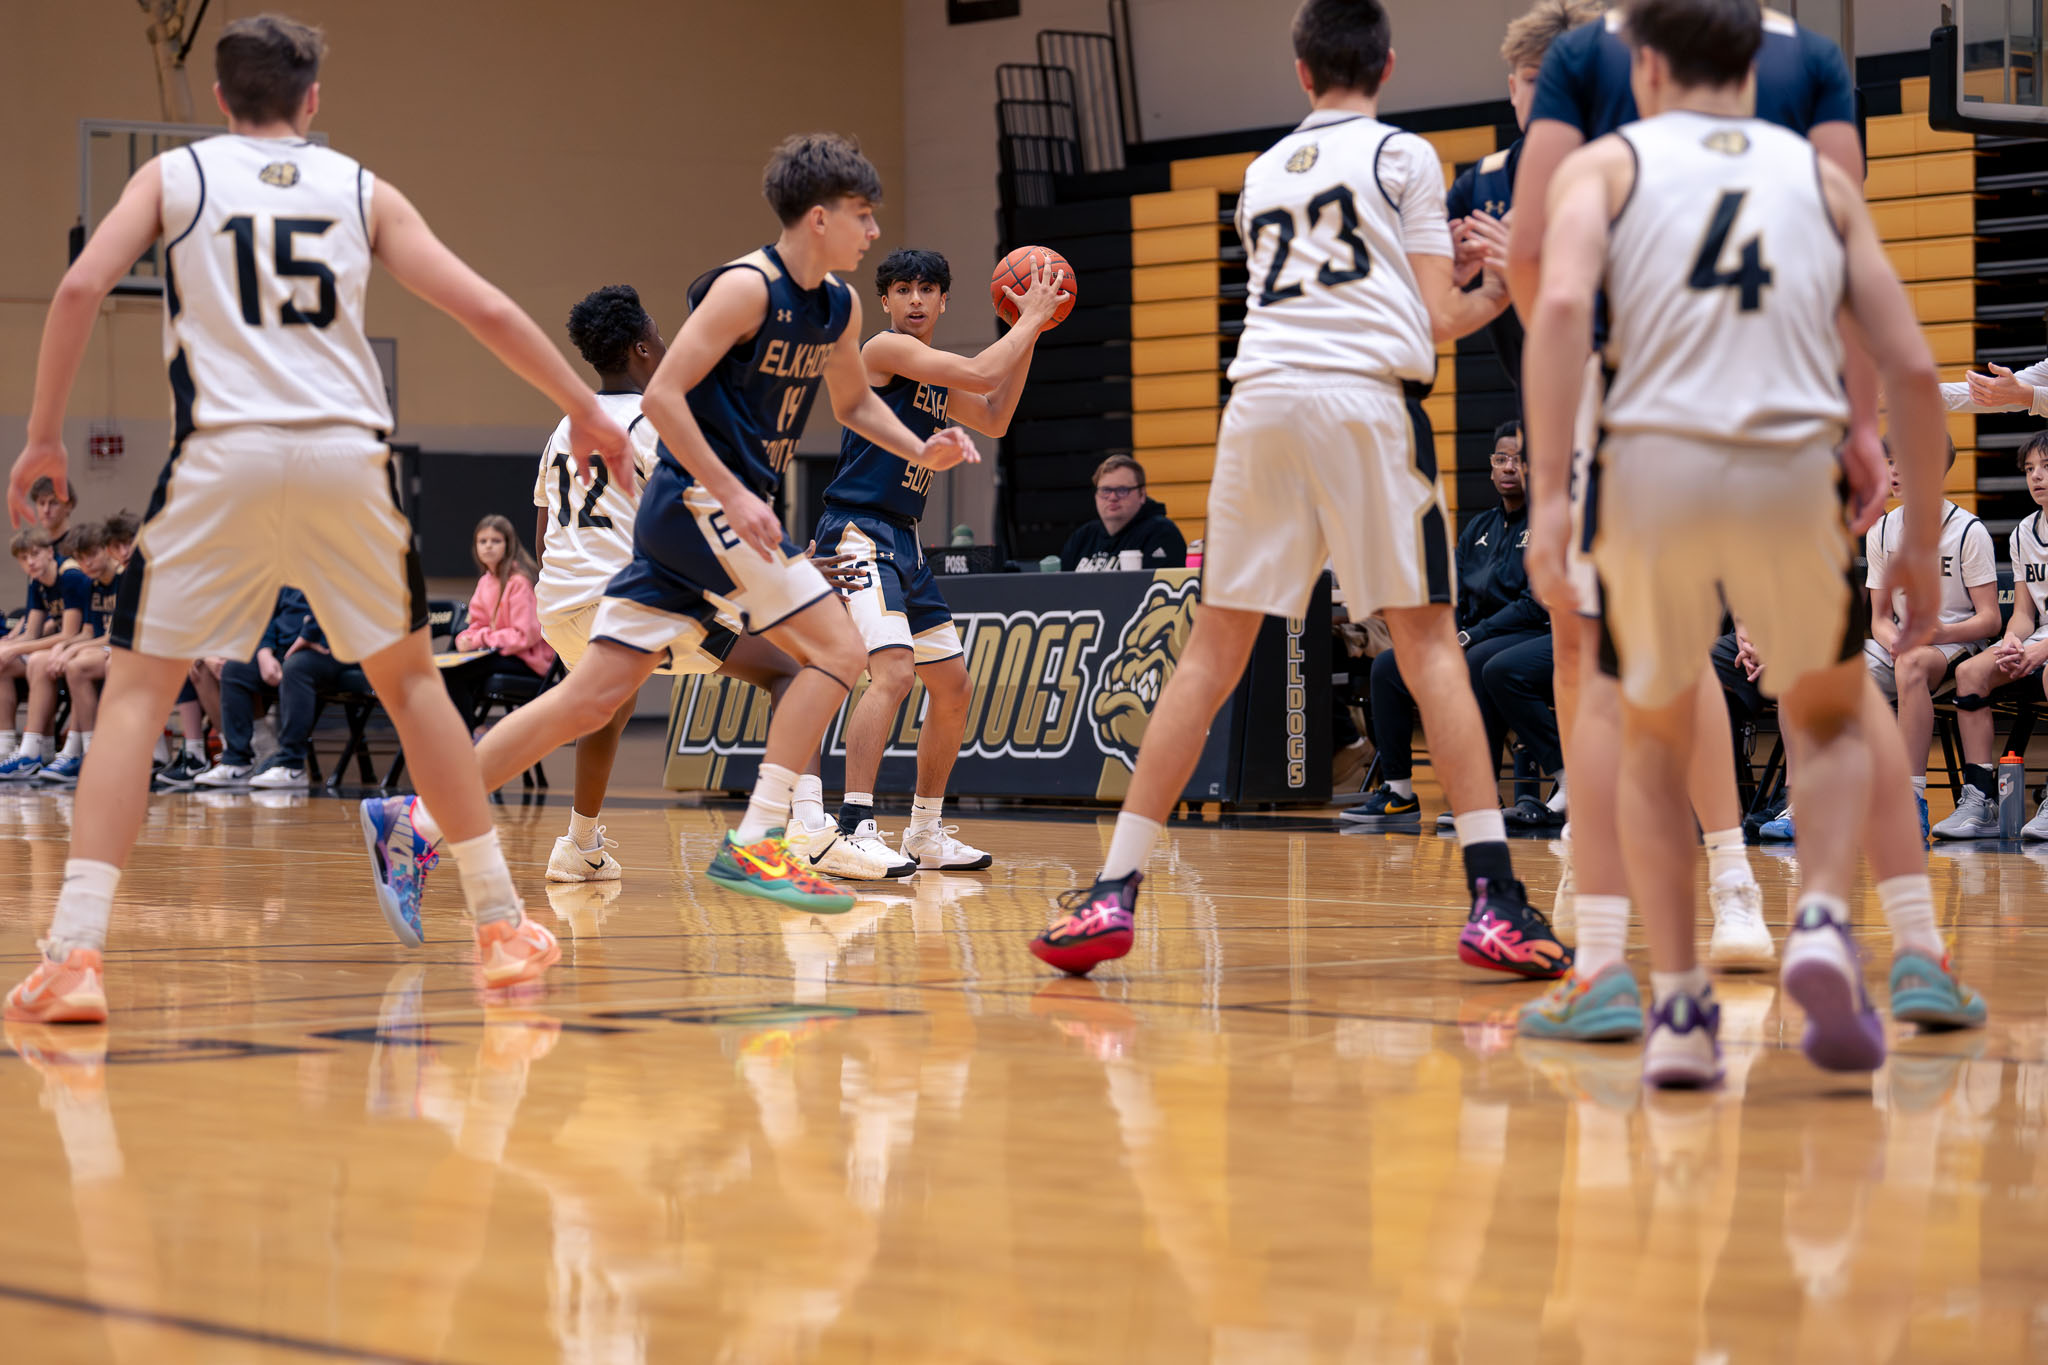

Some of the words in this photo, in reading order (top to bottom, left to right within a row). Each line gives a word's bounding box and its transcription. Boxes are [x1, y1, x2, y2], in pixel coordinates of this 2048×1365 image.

[217, 214, 339, 329] 15
[1250, 184, 1371, 307] 23
[1686, 188, 1774, 314] 4
[776, 385, 806, 432] 14
[551, 452, 613, 528] 12
[945, 555, 969, 574] POSS.
[1287, 616, 1306, 788] ULLDOGS
